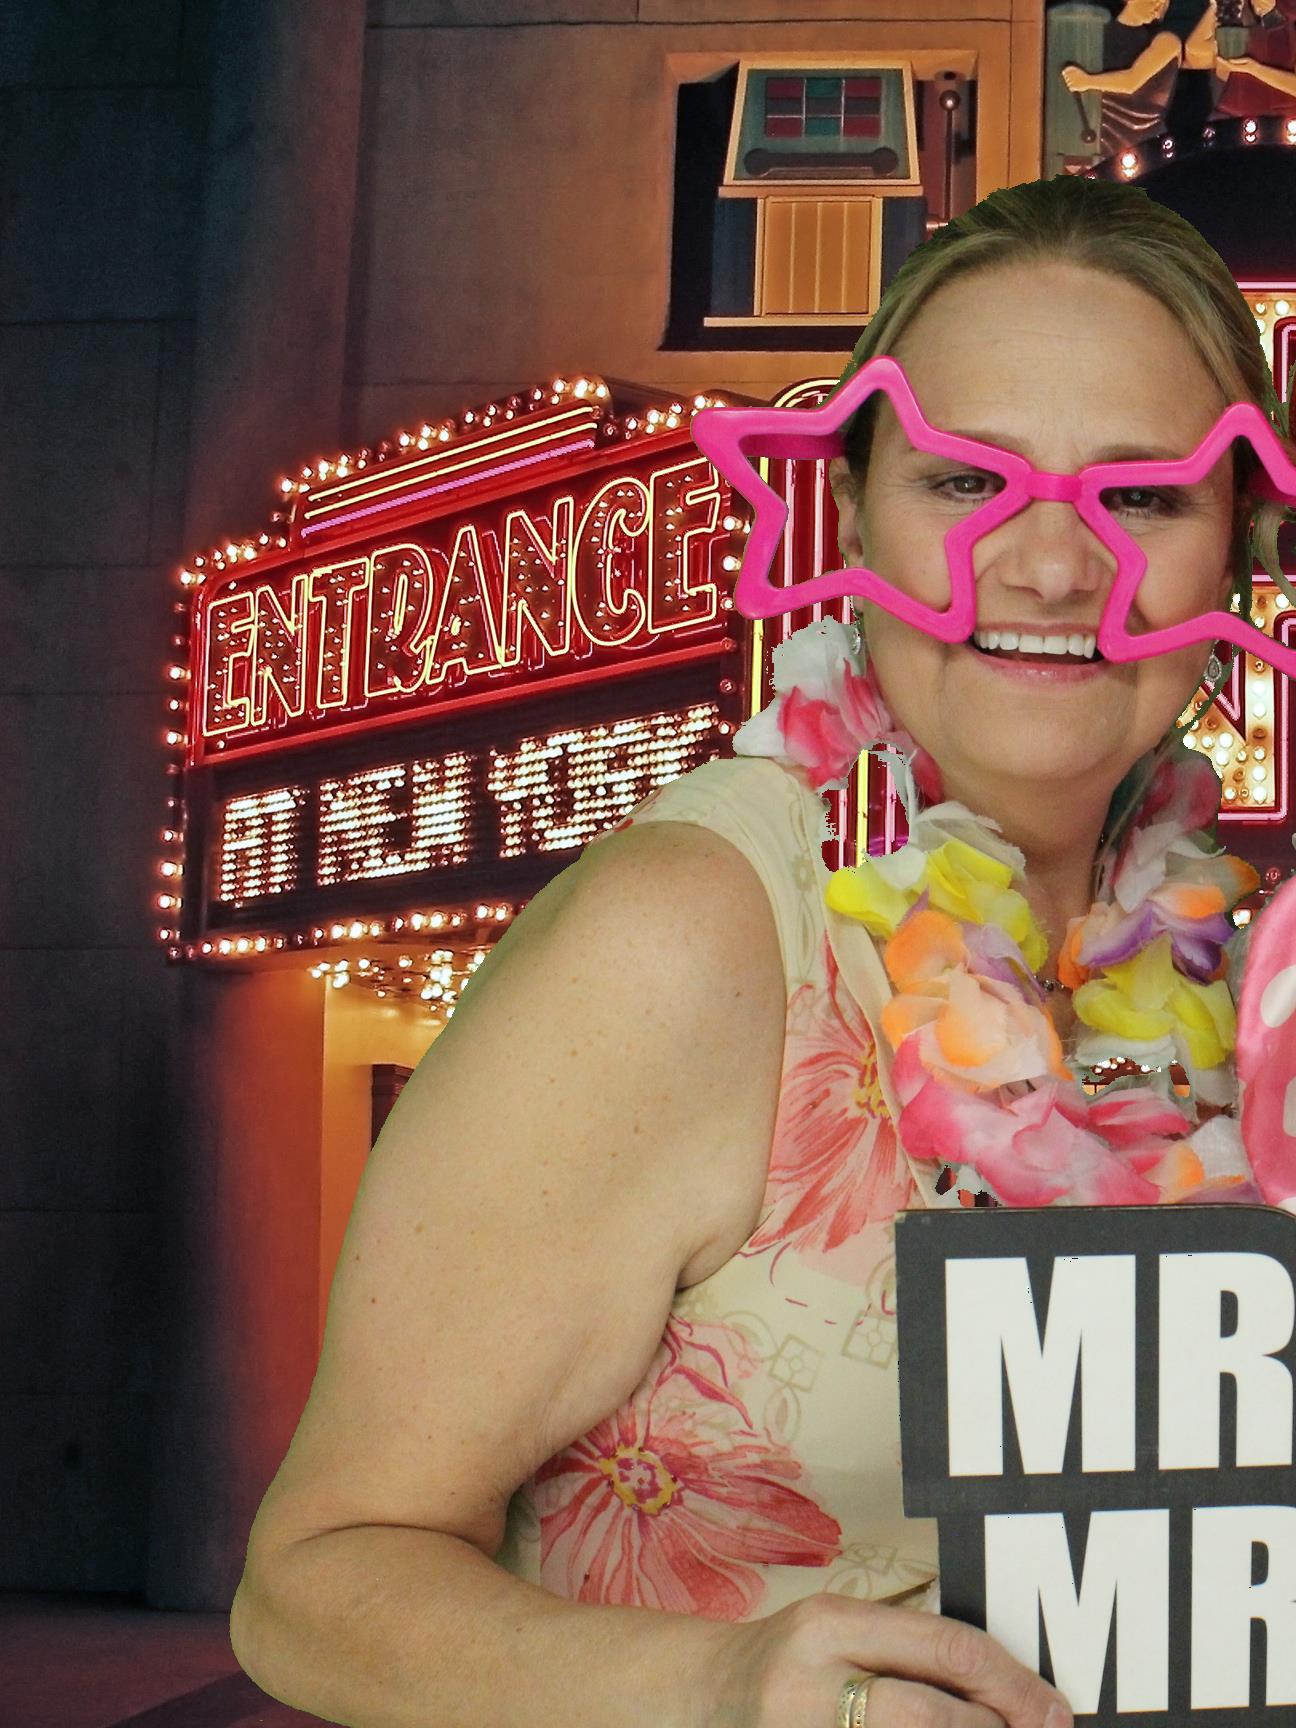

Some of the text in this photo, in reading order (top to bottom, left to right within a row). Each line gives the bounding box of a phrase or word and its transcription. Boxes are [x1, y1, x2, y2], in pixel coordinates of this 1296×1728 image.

[203, 457, 720, 737] ENTRANCE
[219, 787, 311, 904] AT
[317, 753, 472, 886] NEW
[945, 1252, 1296, 1477] MR
